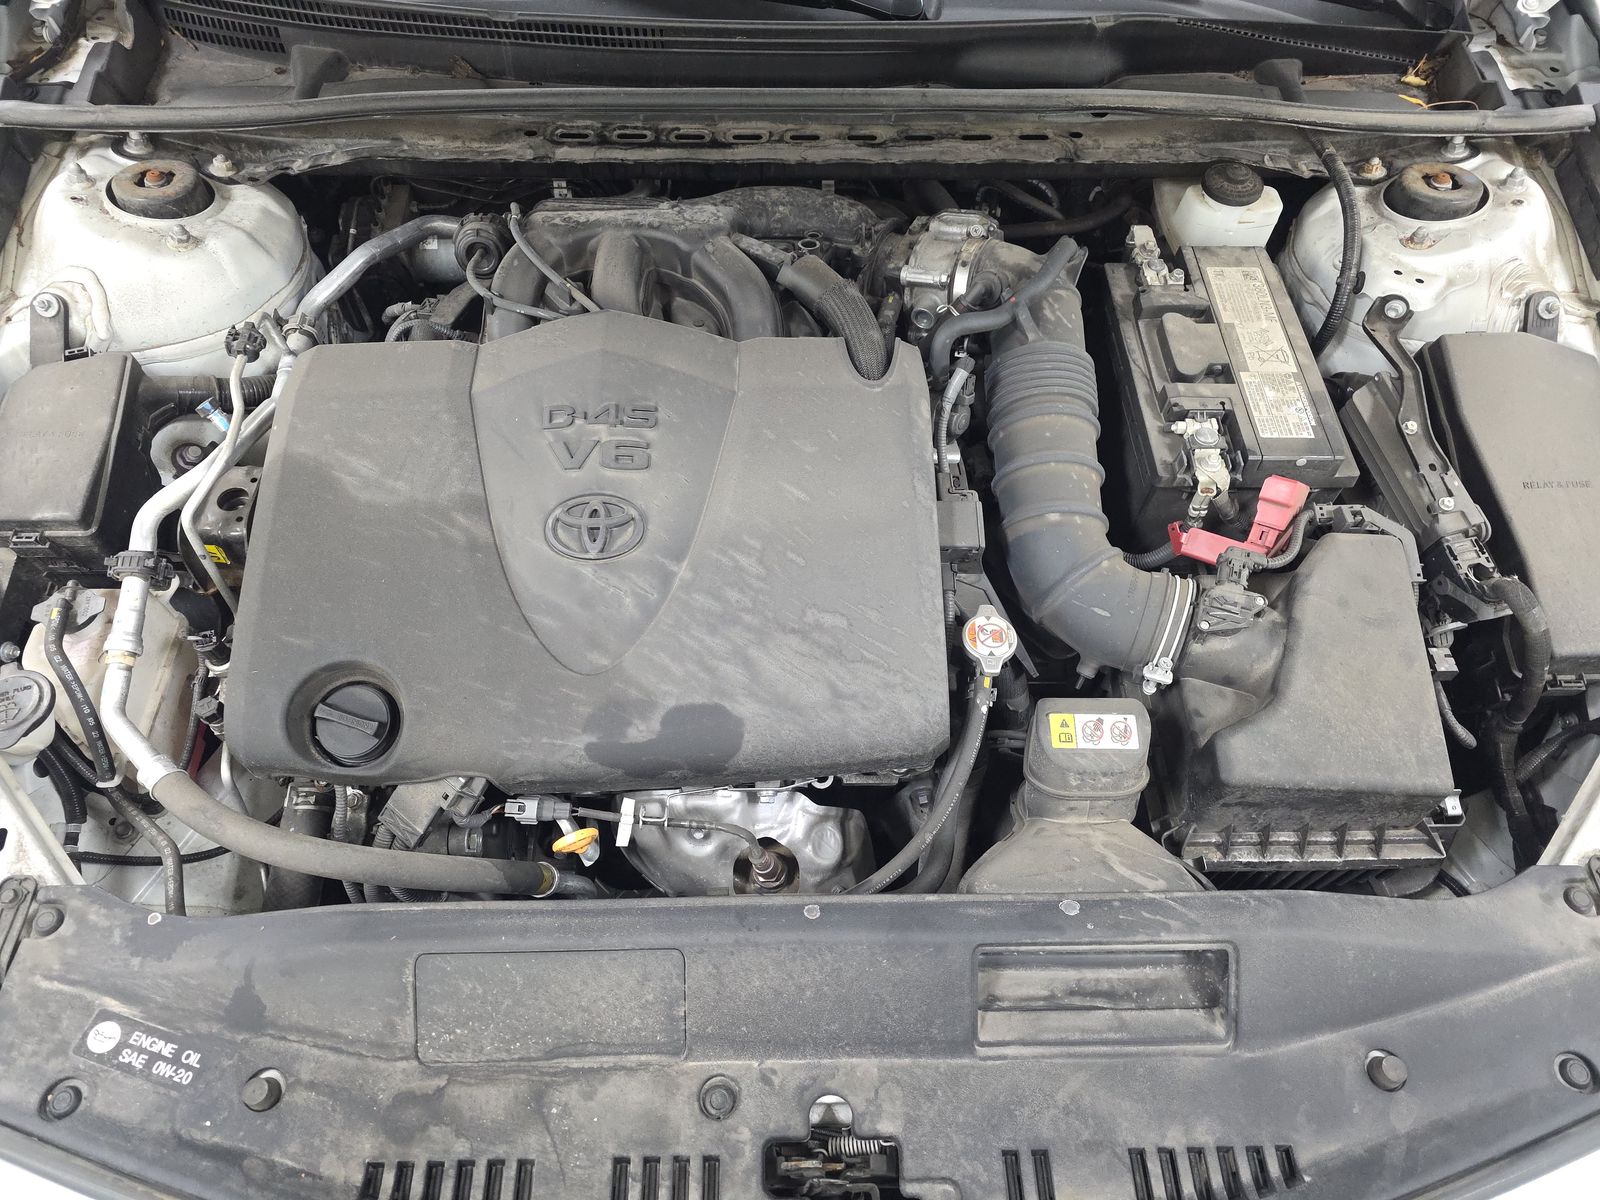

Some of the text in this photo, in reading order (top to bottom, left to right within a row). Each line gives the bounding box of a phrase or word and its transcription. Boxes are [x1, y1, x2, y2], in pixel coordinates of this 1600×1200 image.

[547, 439, 651, 471] V6
[1522, 480, 1554, 489] RELAY
[1565, 480, 1593, 489] FUSE
[118, 1048, 193, 1085] SAE 0W-20
[128, 1031, 202, 1068] ENGINE OIL
